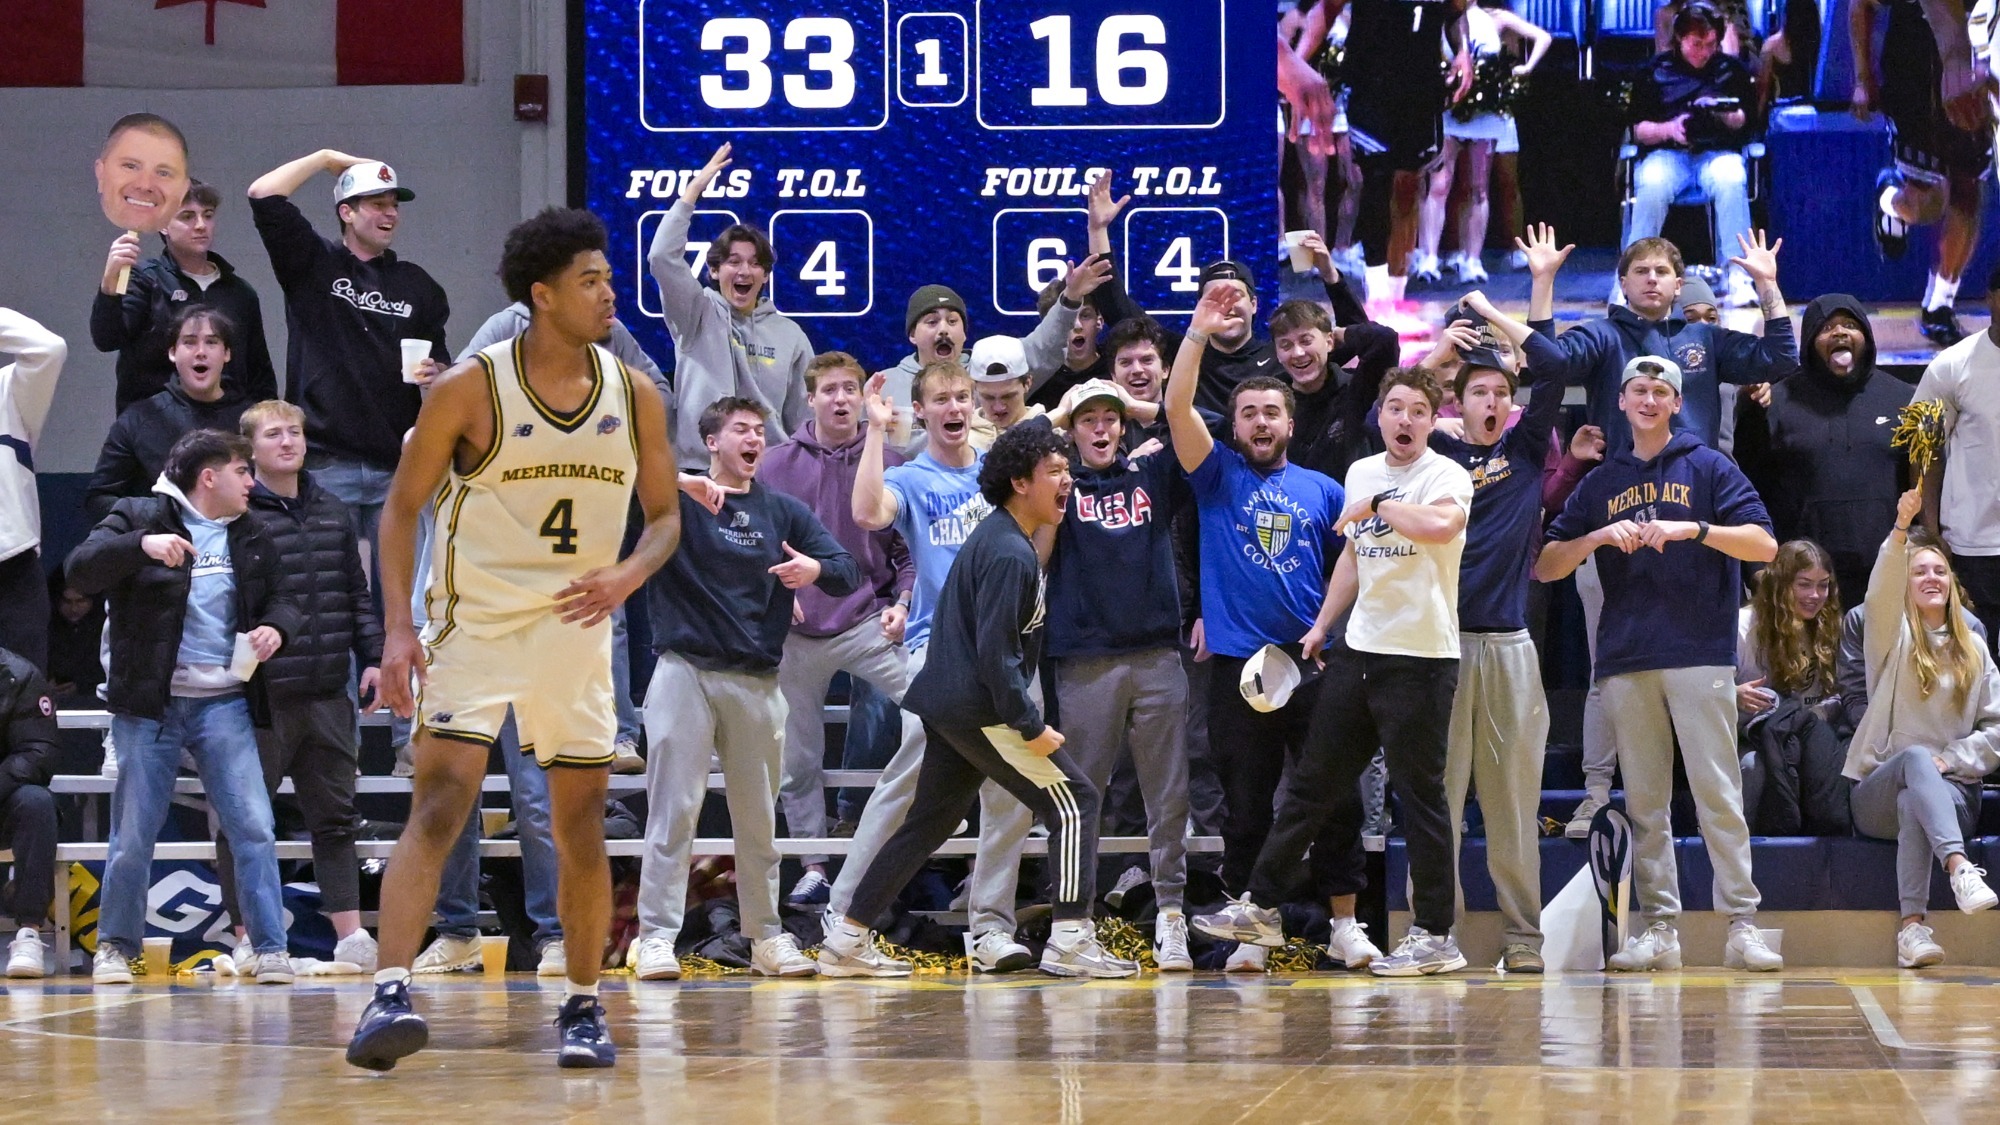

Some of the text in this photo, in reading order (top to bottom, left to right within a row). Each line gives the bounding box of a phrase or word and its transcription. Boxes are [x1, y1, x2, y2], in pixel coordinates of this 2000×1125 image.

[700, 17, 855, 109] 33
[915, 38, 948, 86] 1
[1029, 14, 1168, 106] 16
[777, 169, 866, 197] T.O.L
[1132, 166, 1222, 196] T.O.L
[800, 240, 846, 296] 4
[1027, 237, 1068, 293] 6
[1154, 236, 1201, 292] 4
[500, 463, 626, 486] MERRIMACK
[539, 498, 578, 554] 4
[1074, 486, 1152, 530] USA
[1606, 481, 1692, 521] MERRIMACK
